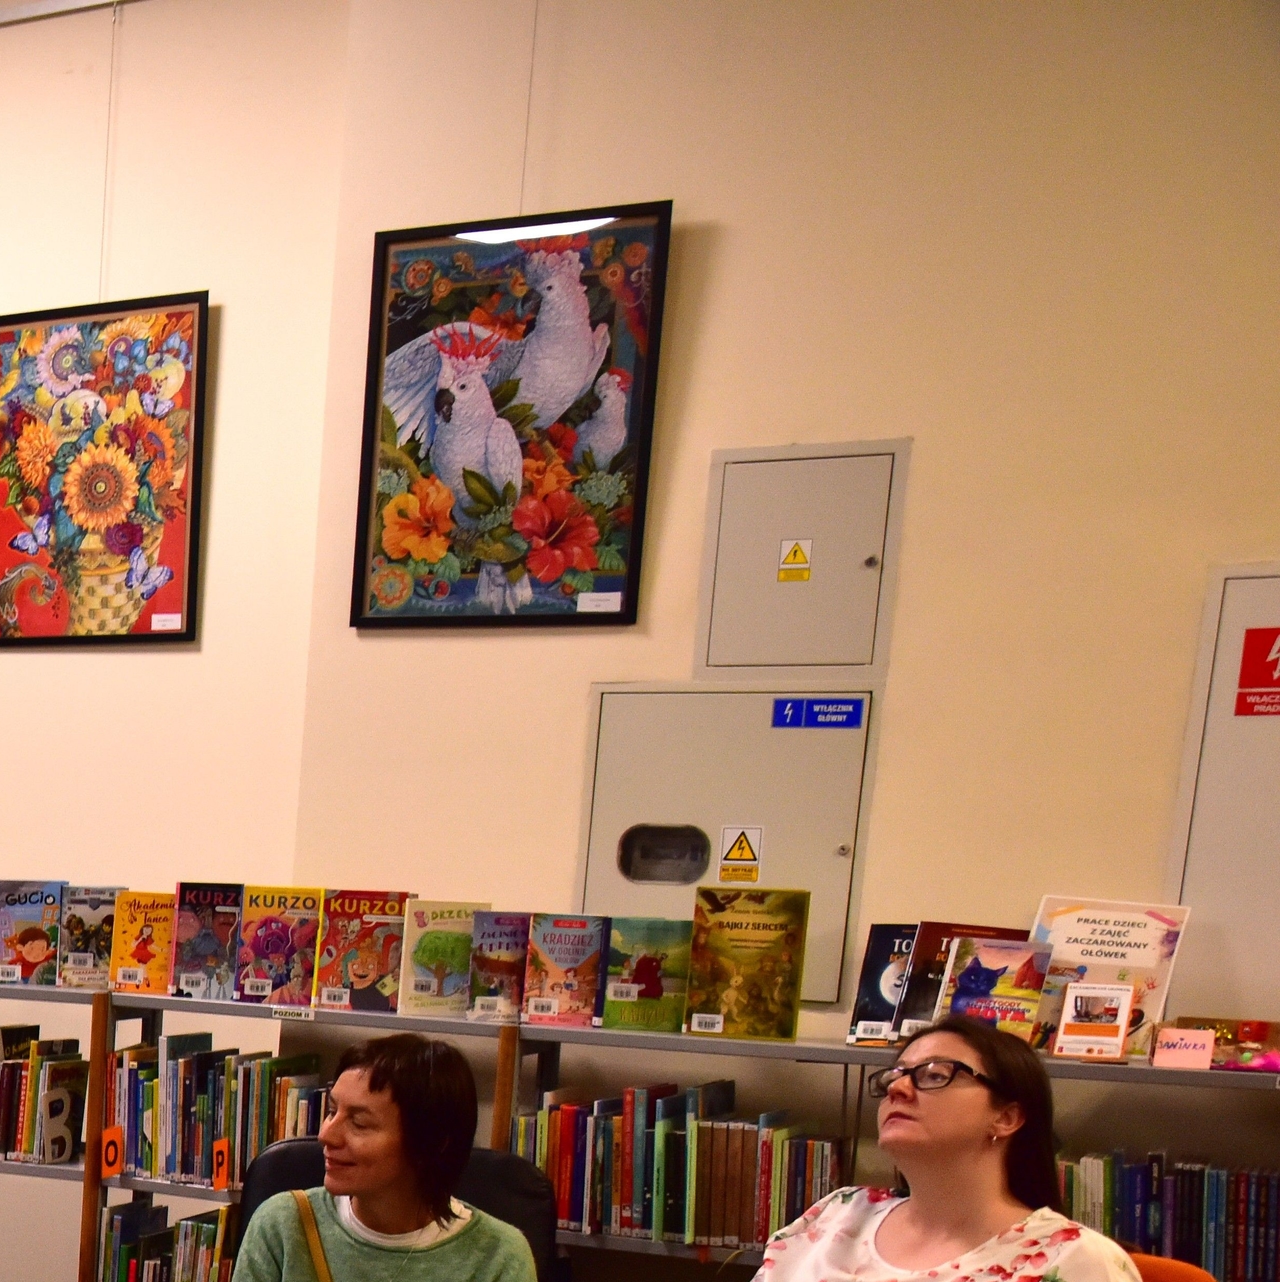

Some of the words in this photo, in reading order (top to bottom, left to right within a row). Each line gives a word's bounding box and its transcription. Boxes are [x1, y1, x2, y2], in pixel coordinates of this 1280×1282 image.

[813, 704, 854, 713] WYŁĄCZNIK
[817, 713, 848, 723] GŁÓWNY
[184, 889, 240, 907] KURZ
[718, 921, 743, 931] BAJKI
[744, 922, 751, 931] Z
[751, 922, 789, 932] SERCEM
[1077, 917, 1111, 927] PRACE
[1113, 919, 1148, 929] DZIECI
[1090, 928, 1099, 936] Z
[1099, 928, 1130, 939] ZAJĘĆ
[1065, 936, 1149, 950] ZACZAROWANY
[1080, 947, 1128, 960] OŁÓWEK
[273, 1009, 303, 1018] POZIOM
[42, 1086, 73, 1165] B
[104, 1139, 119, 1168] O
[215, 1148, 226, 1180] P
